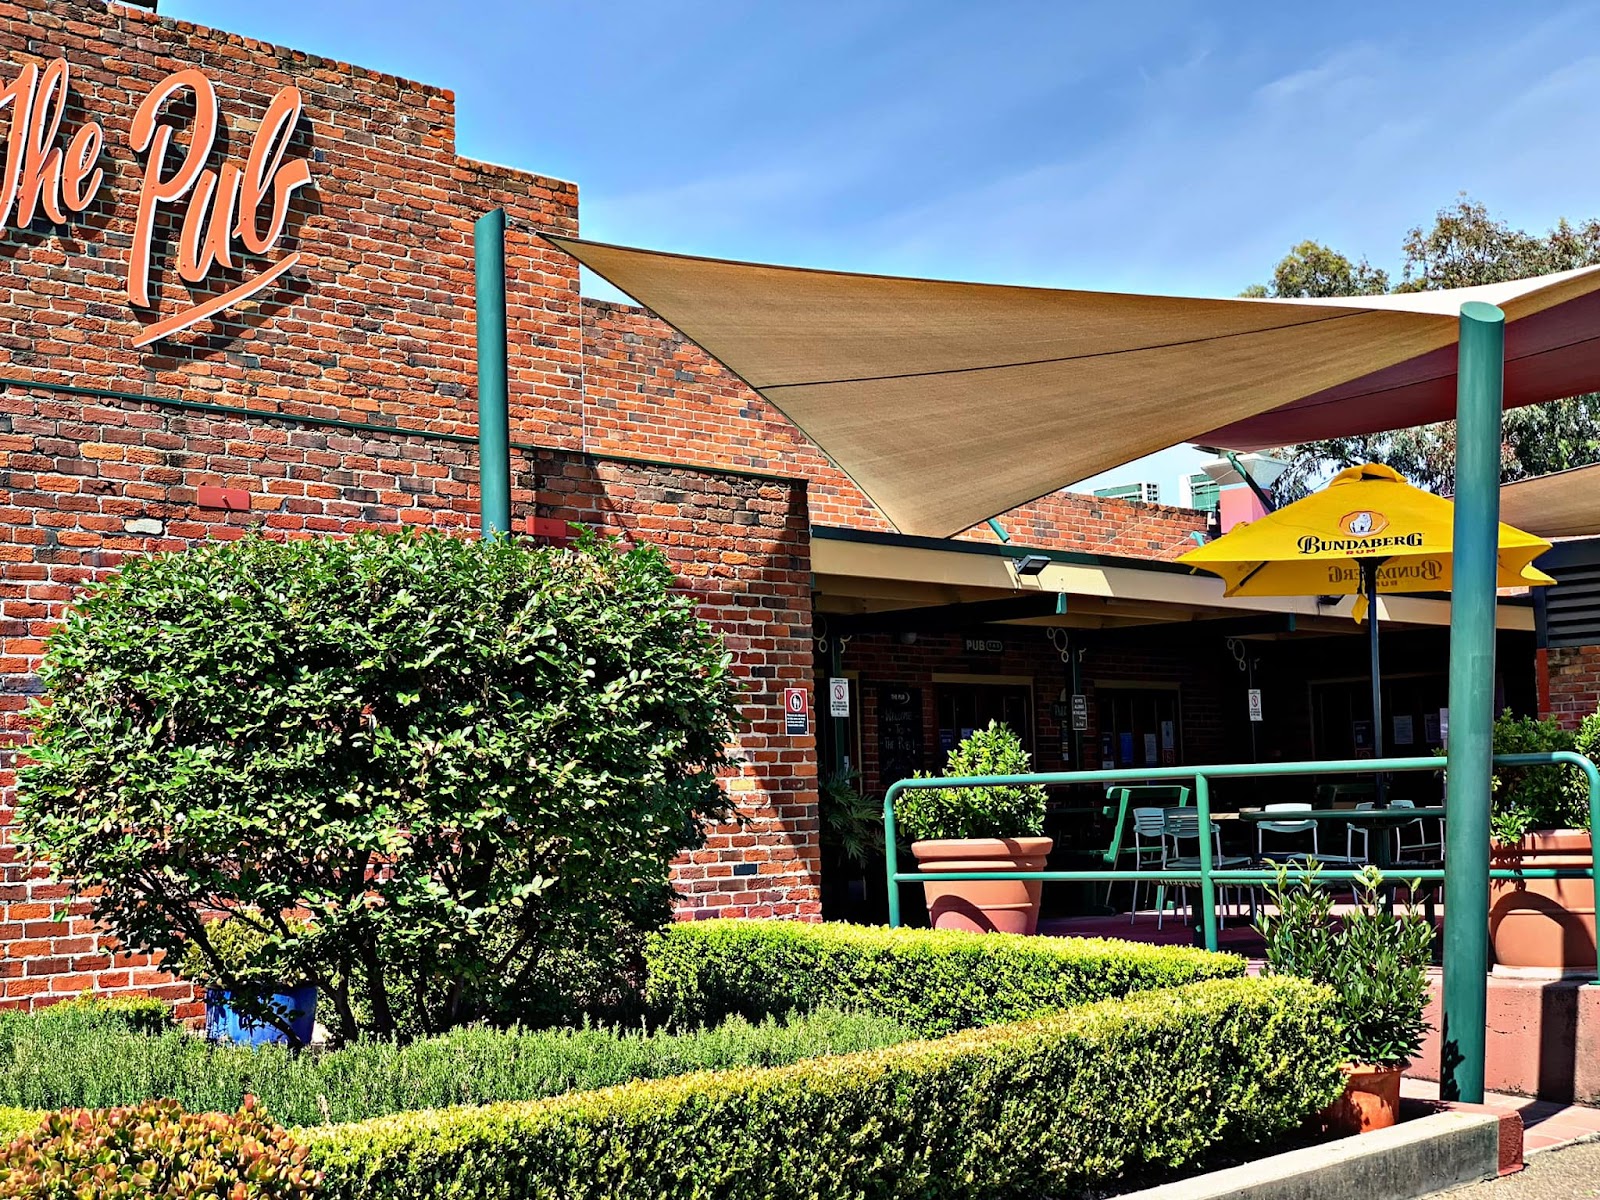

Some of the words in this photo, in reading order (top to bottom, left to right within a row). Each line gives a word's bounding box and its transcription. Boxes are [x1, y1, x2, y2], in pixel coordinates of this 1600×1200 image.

[0, 57, 103, 229] The
[129, 69, 312, 307] Pub
[1297, 532, 1423, 554] BUNDABERG
[966, 639, 985, 651] PUB
